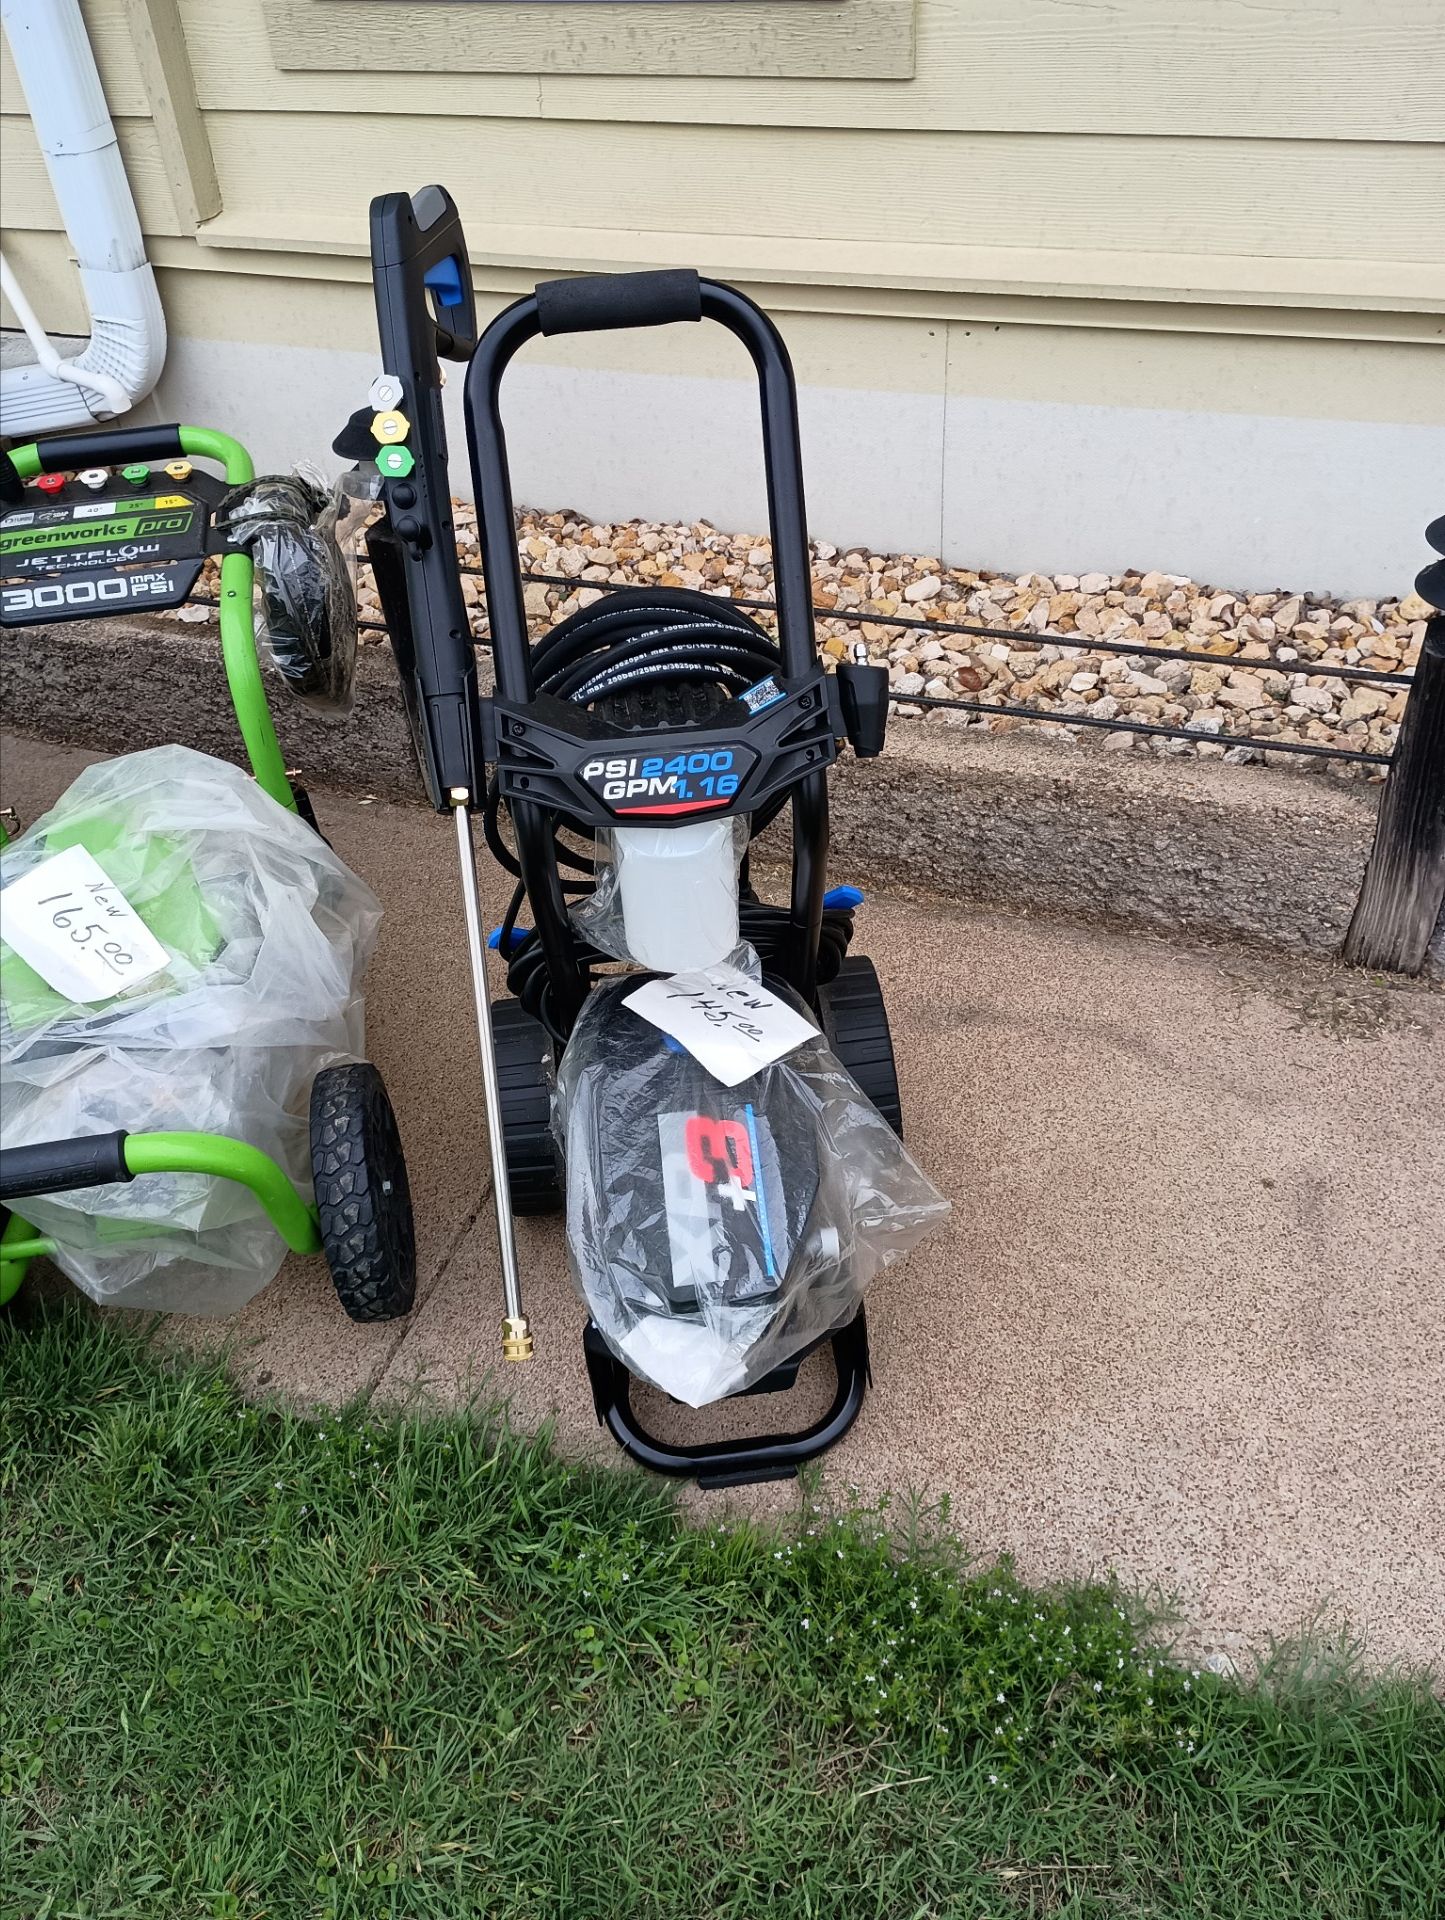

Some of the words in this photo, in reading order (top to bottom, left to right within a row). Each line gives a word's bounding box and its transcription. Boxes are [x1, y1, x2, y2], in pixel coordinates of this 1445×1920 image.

[0, 524, 128, 551] greenworks
[138, 518, 183, 535] pro
[16, 544, 160, 568] JETTFLOW
[36, 554, 138, 572] TECHNOLOGY
[130, 573, 166, 582] MAX
[131, 580, 174, 597] PSI
[2, 578, 128, 612] 3000
[650, 648, 669, 656] max
[587, 682, 605, 695] max
[583, 758, 637, 781] PSI
[641, 751, 733, 778] 2400
[603, 775, 677, 800] GPM
[672, 774, 739, 799] 1.16
[85, 883, 129, 916] New
